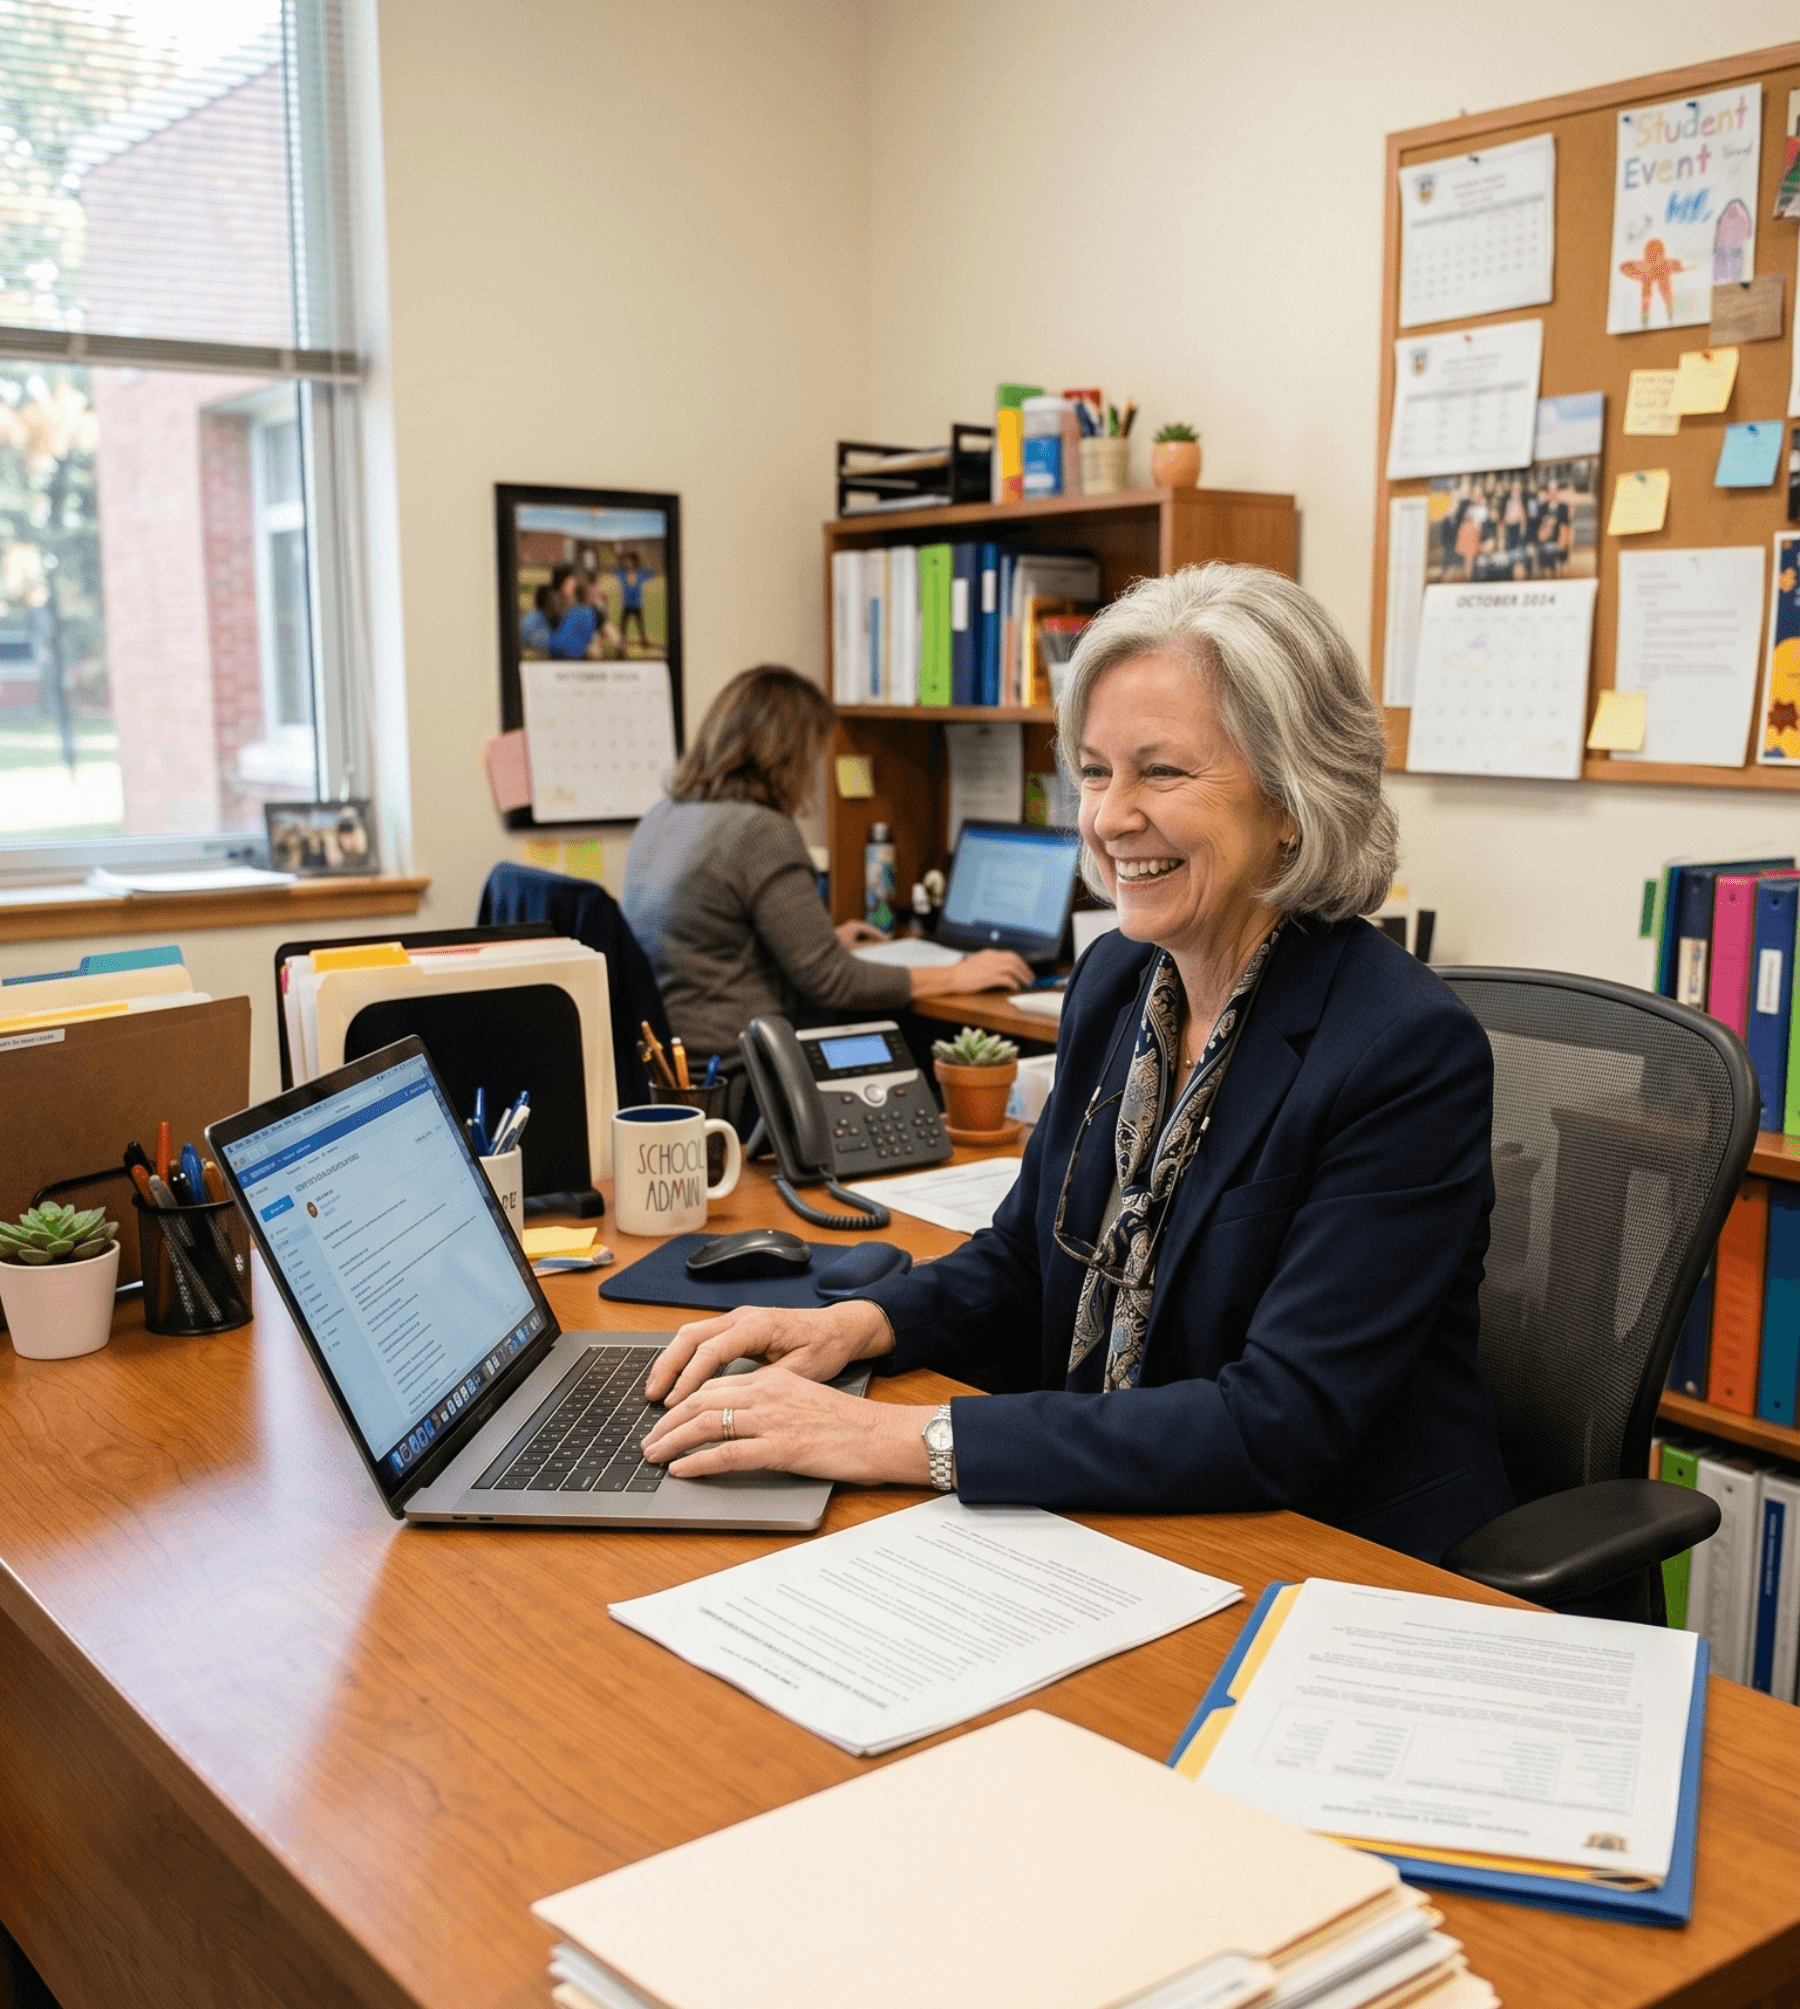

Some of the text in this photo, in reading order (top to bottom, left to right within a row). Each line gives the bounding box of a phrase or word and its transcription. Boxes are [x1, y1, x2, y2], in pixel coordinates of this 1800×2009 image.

[1635, 95, 1748, 148] Student
[1624, 143, 1711, 190] Event
[1456, 592, 1556, 608] OCTOBER 2024
[637, 1139, 704, 1175] SCHOOL
[646, 1175, 700, 1212] ADMIN
